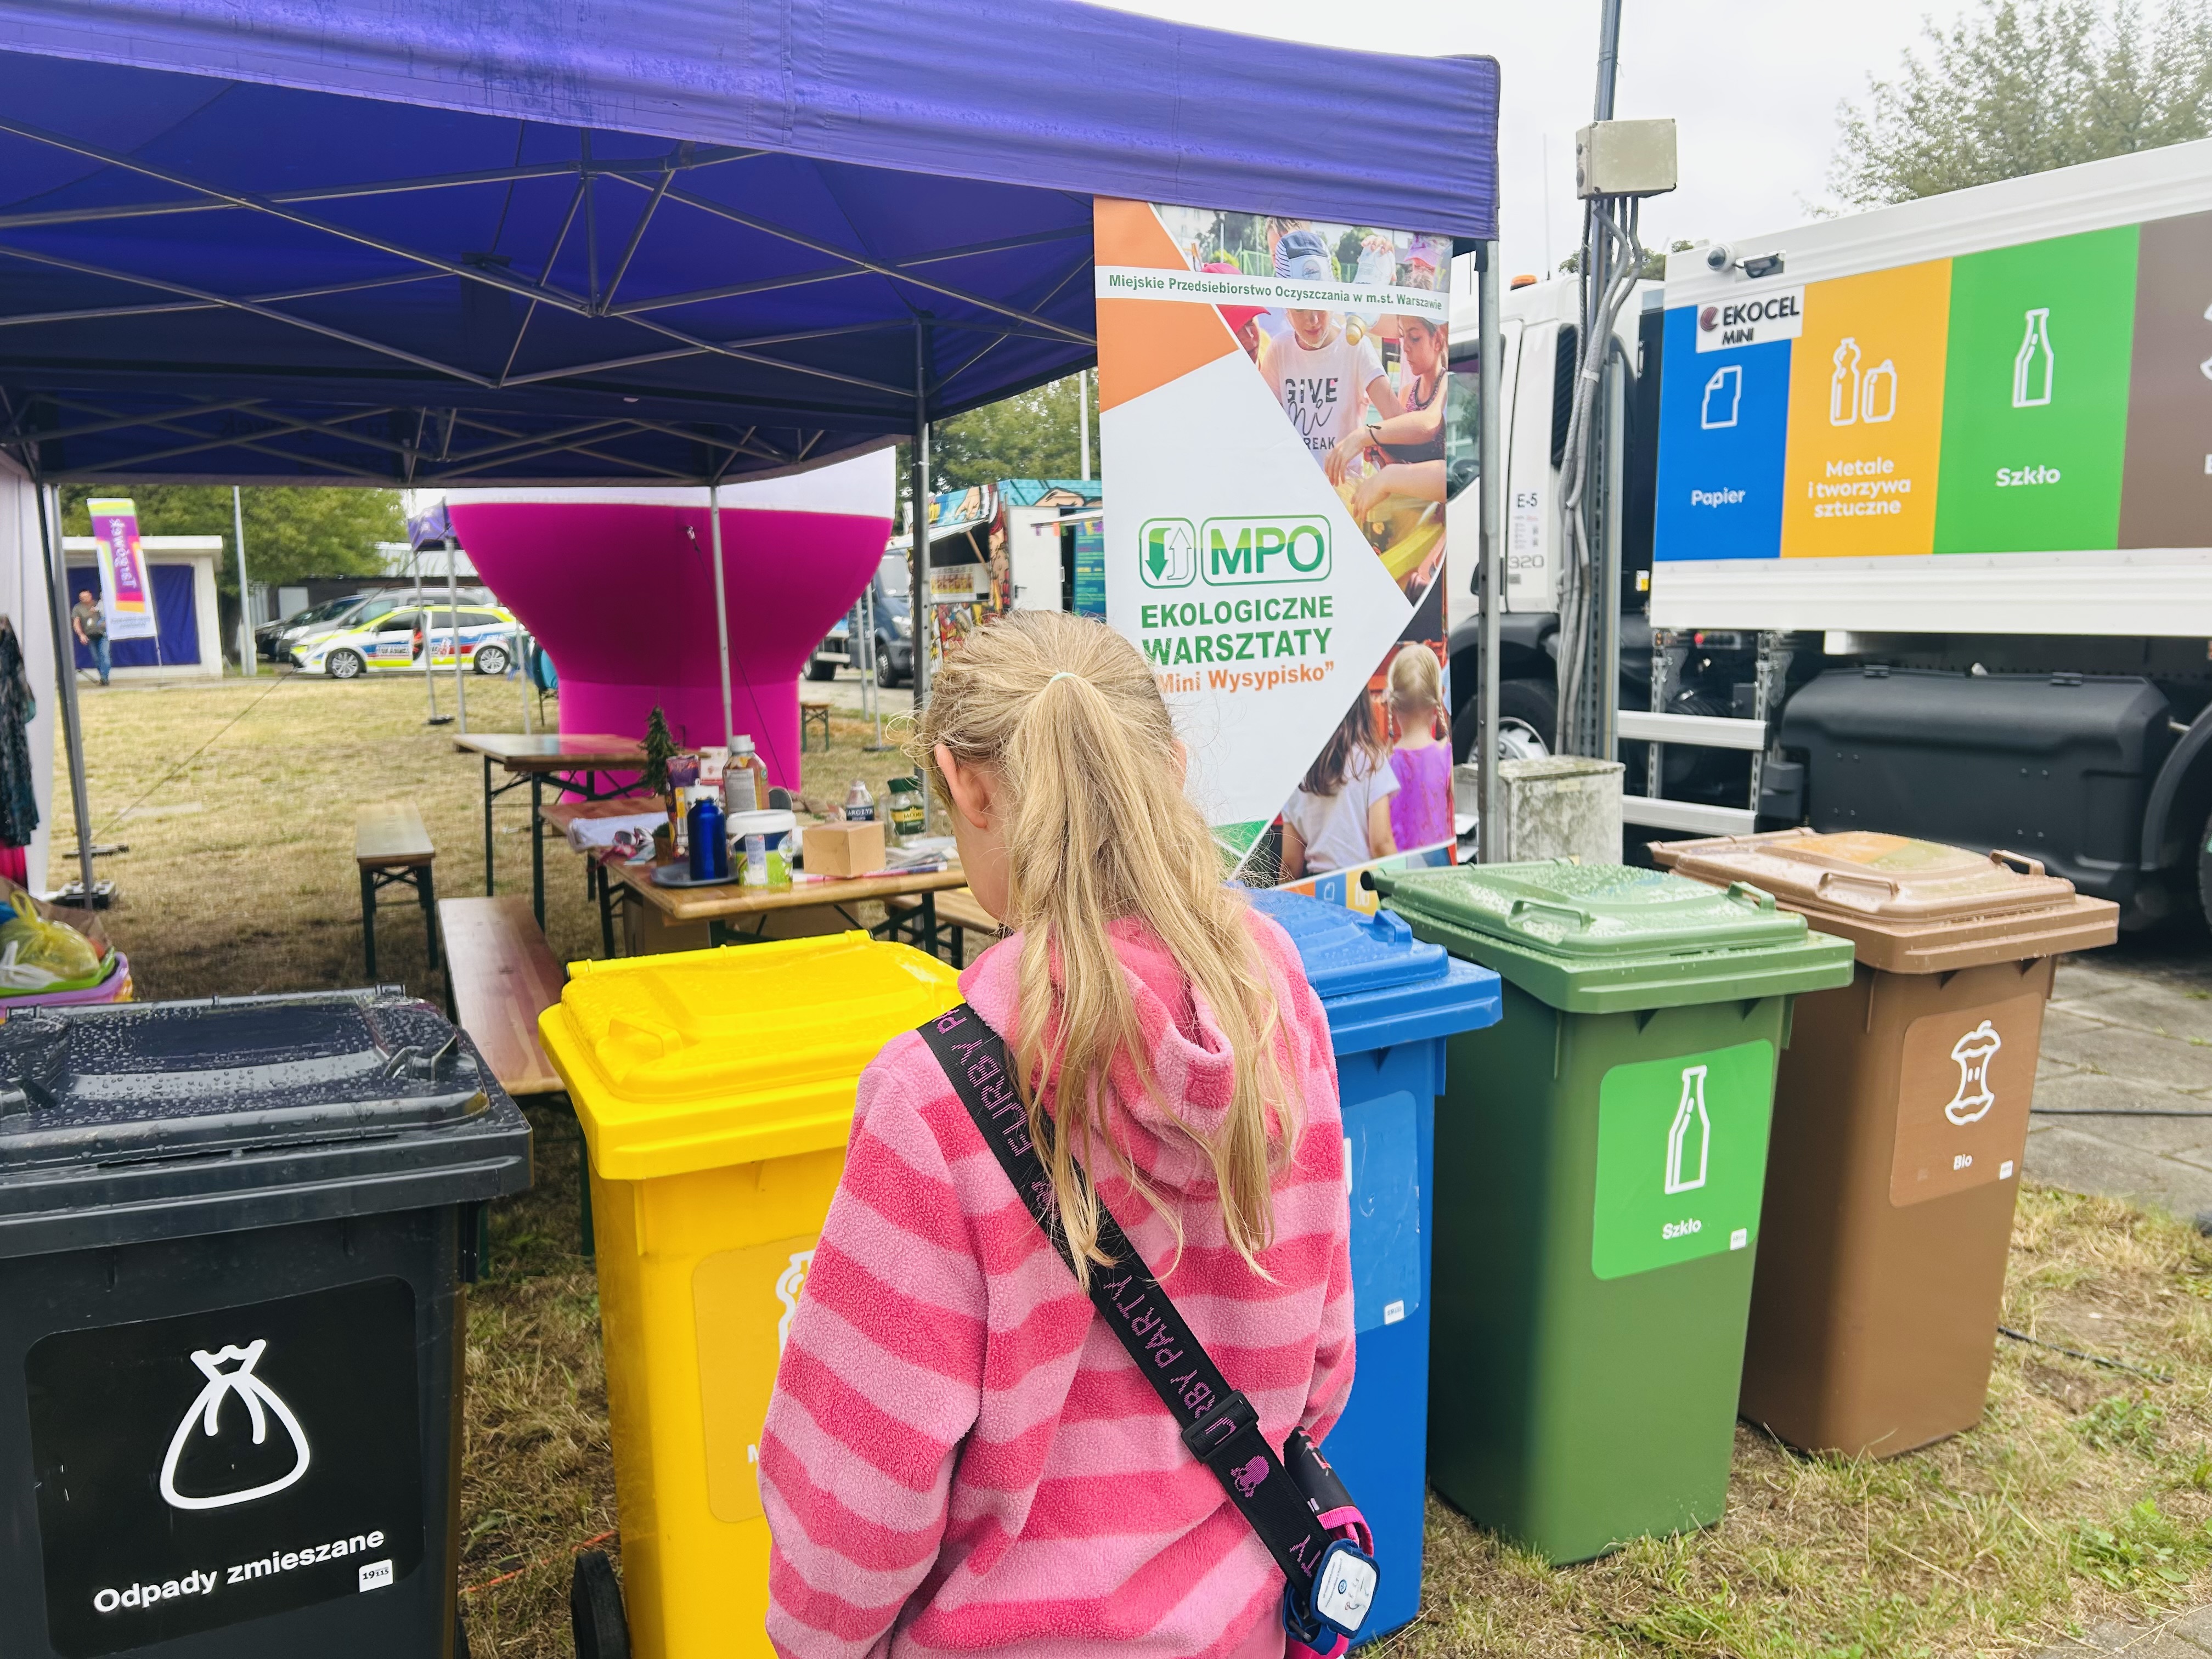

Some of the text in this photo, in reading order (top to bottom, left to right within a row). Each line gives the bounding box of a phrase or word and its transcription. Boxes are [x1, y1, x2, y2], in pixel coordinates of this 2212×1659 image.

[1109, 274, 1164, 290] Miejskie
[1275, 285, 1350, 302] Oczyszczania
[1353, 293, 1363, 302] w
[1366, 292, 1394, 304] m.st.
[1396, 292, 1443, 311] Warszawie
[1723, 296, 1800, 326] EKOCEL
[1722, 328, 1754, 345] MINI
[1285, 377, 1339, 404] GIVE
[1304, 437, 1335, 450] REAK
[1826, 457, 1894, 477] Metale
[1996, 465, 2061, 487] Szkło
[1691, 486, 1746, 508] Papier
[1808, 475, 1911, 501] i tworzywa
[1517, 493, 1538, 509] E-5
[1814, 498, 1902, 518] sztuczne
[1211, 525, 1325, 575] MPO
[1509, 555, 1544, 568] 320
[1141, 596, 1334, 629] EKOLOGICZNE
[1142, 628, 1333, 666] WARSZTATY
[846, 808, 873, 816] ARCZYN
[951, 1039, 1033, 1156] FURBY
[1954, 1154, 1973, 1171] Bio
[1662, 1217, 1702, 1240] Szkło
[1103, 1275, 1184, 1368] PARTY
[93, 1530, 385, 1613] Odpady zmieszane
